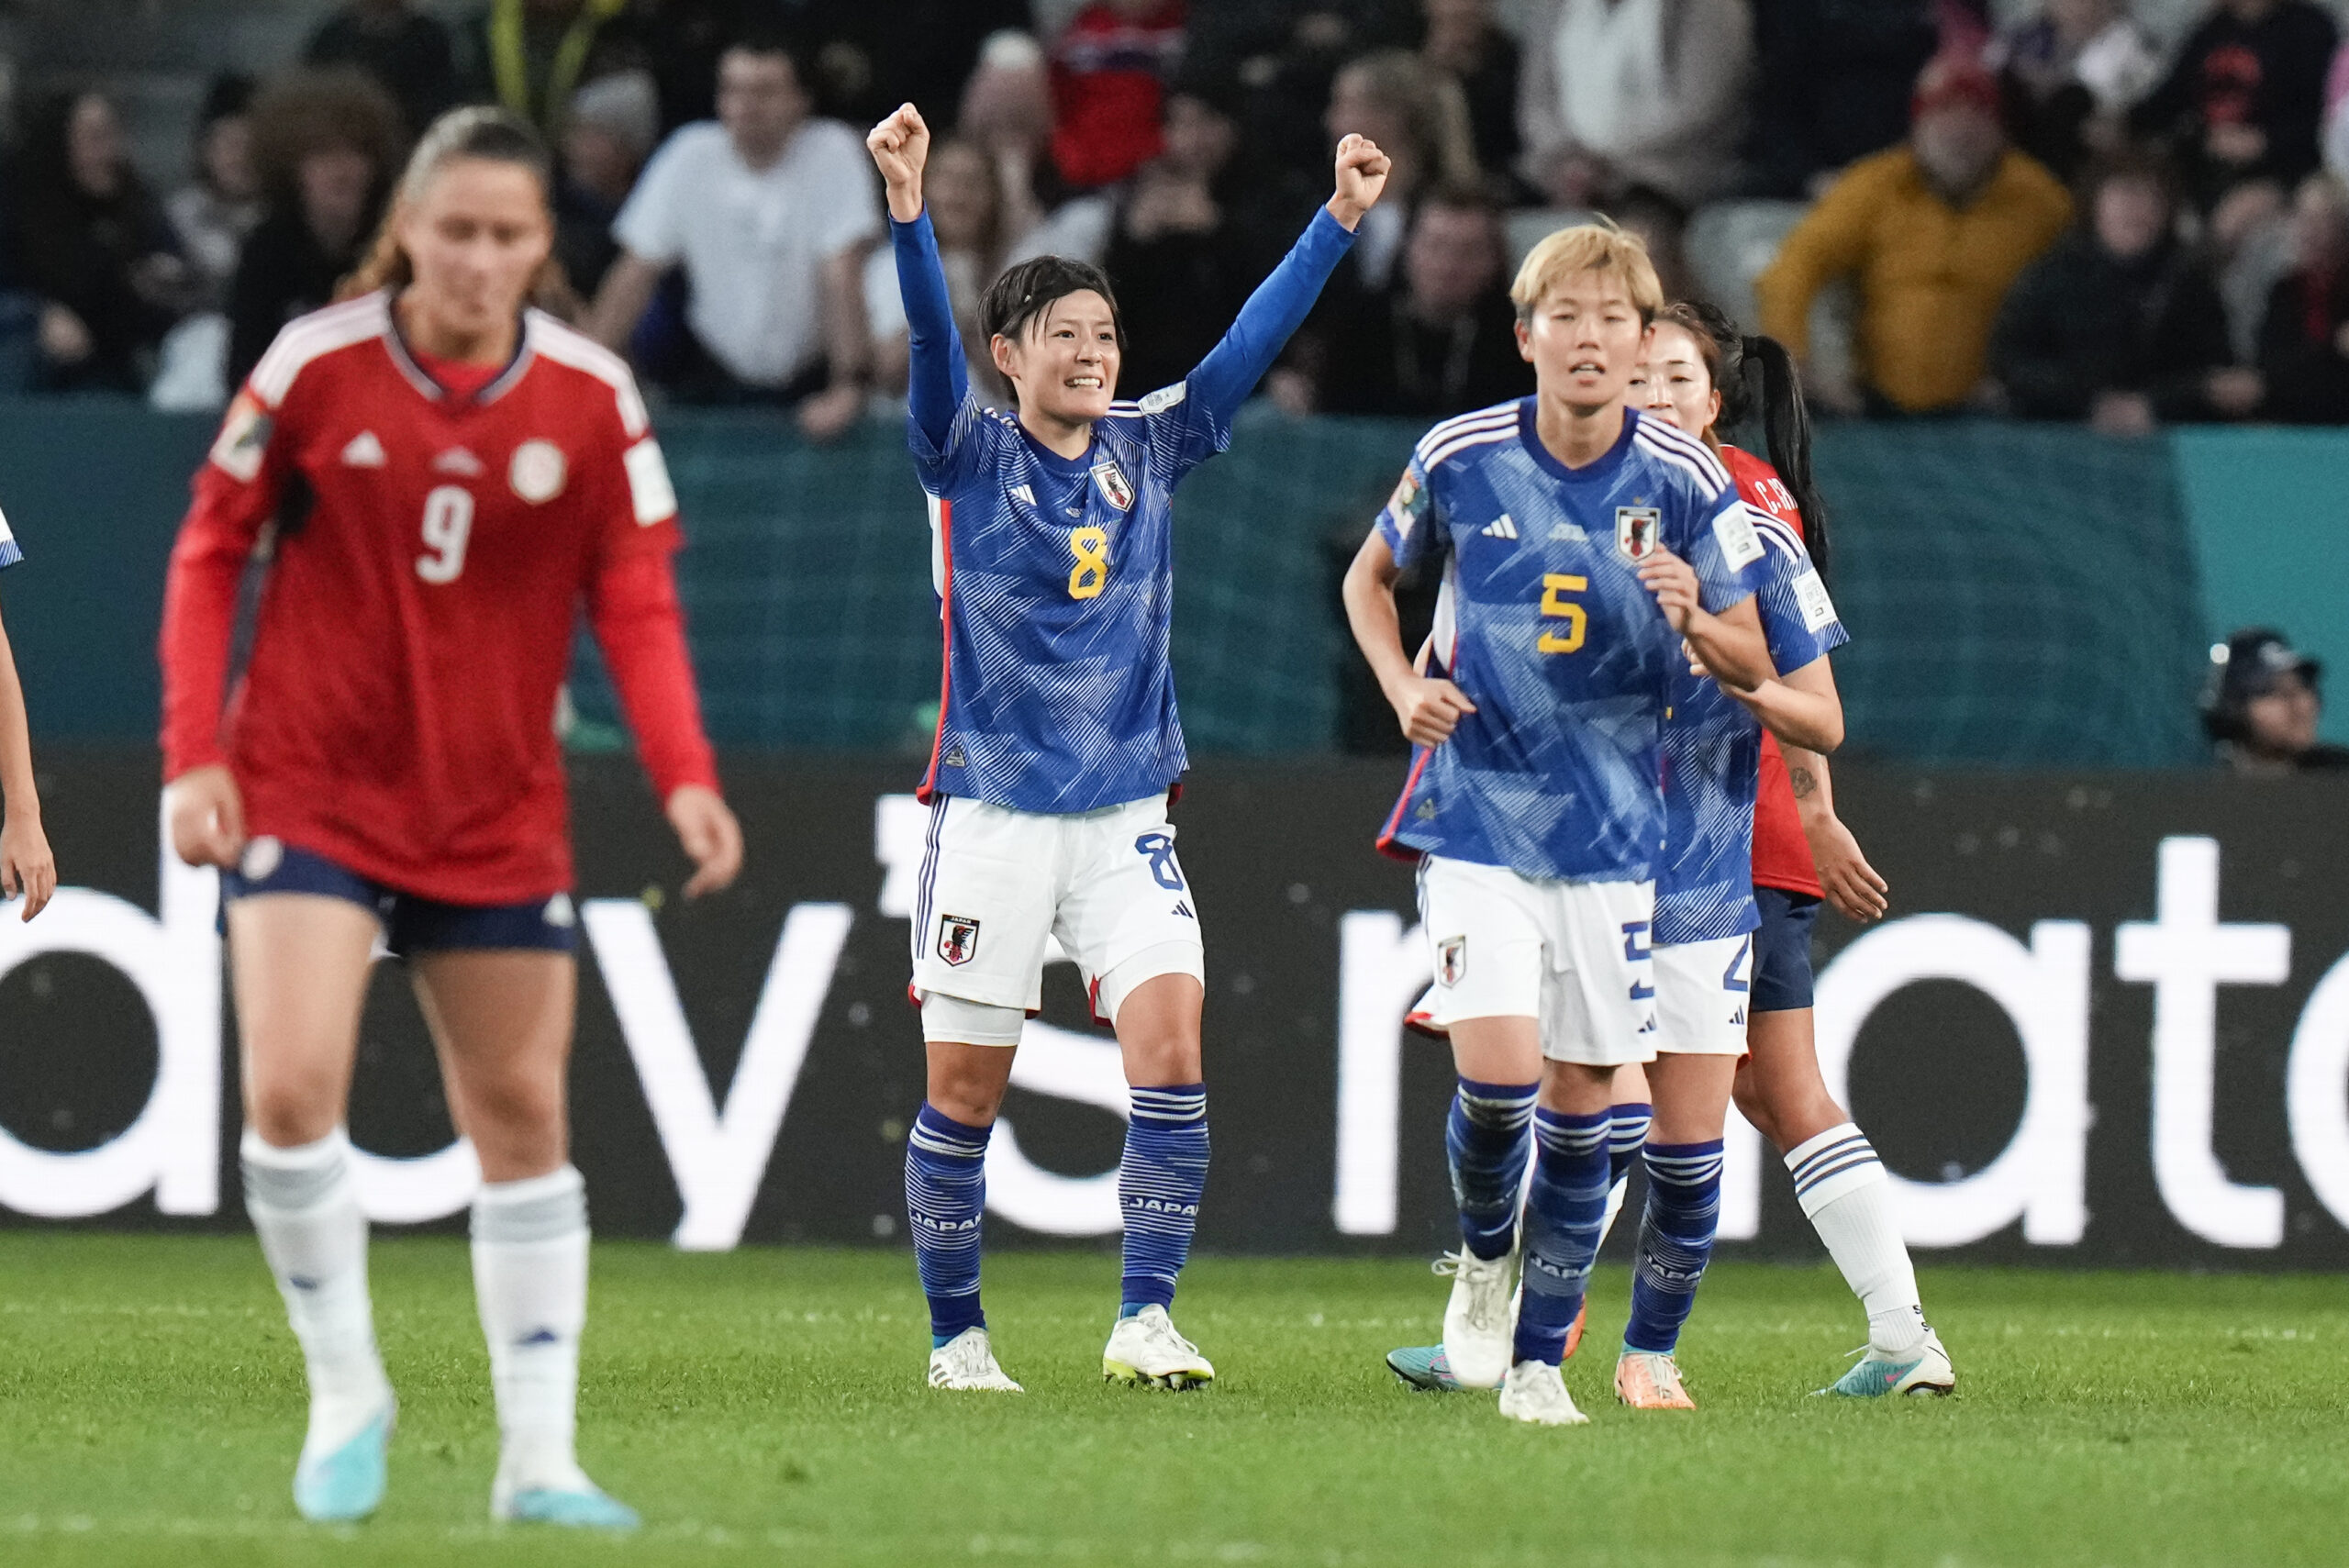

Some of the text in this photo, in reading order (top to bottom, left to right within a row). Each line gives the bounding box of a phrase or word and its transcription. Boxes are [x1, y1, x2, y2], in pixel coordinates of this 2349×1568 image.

[415, 484, 475, 584] 9
[1067, 525, 1109, 601] 8
[1536, 573, 1588, 654] 5
[1134, 832, 1184, 892] 8
